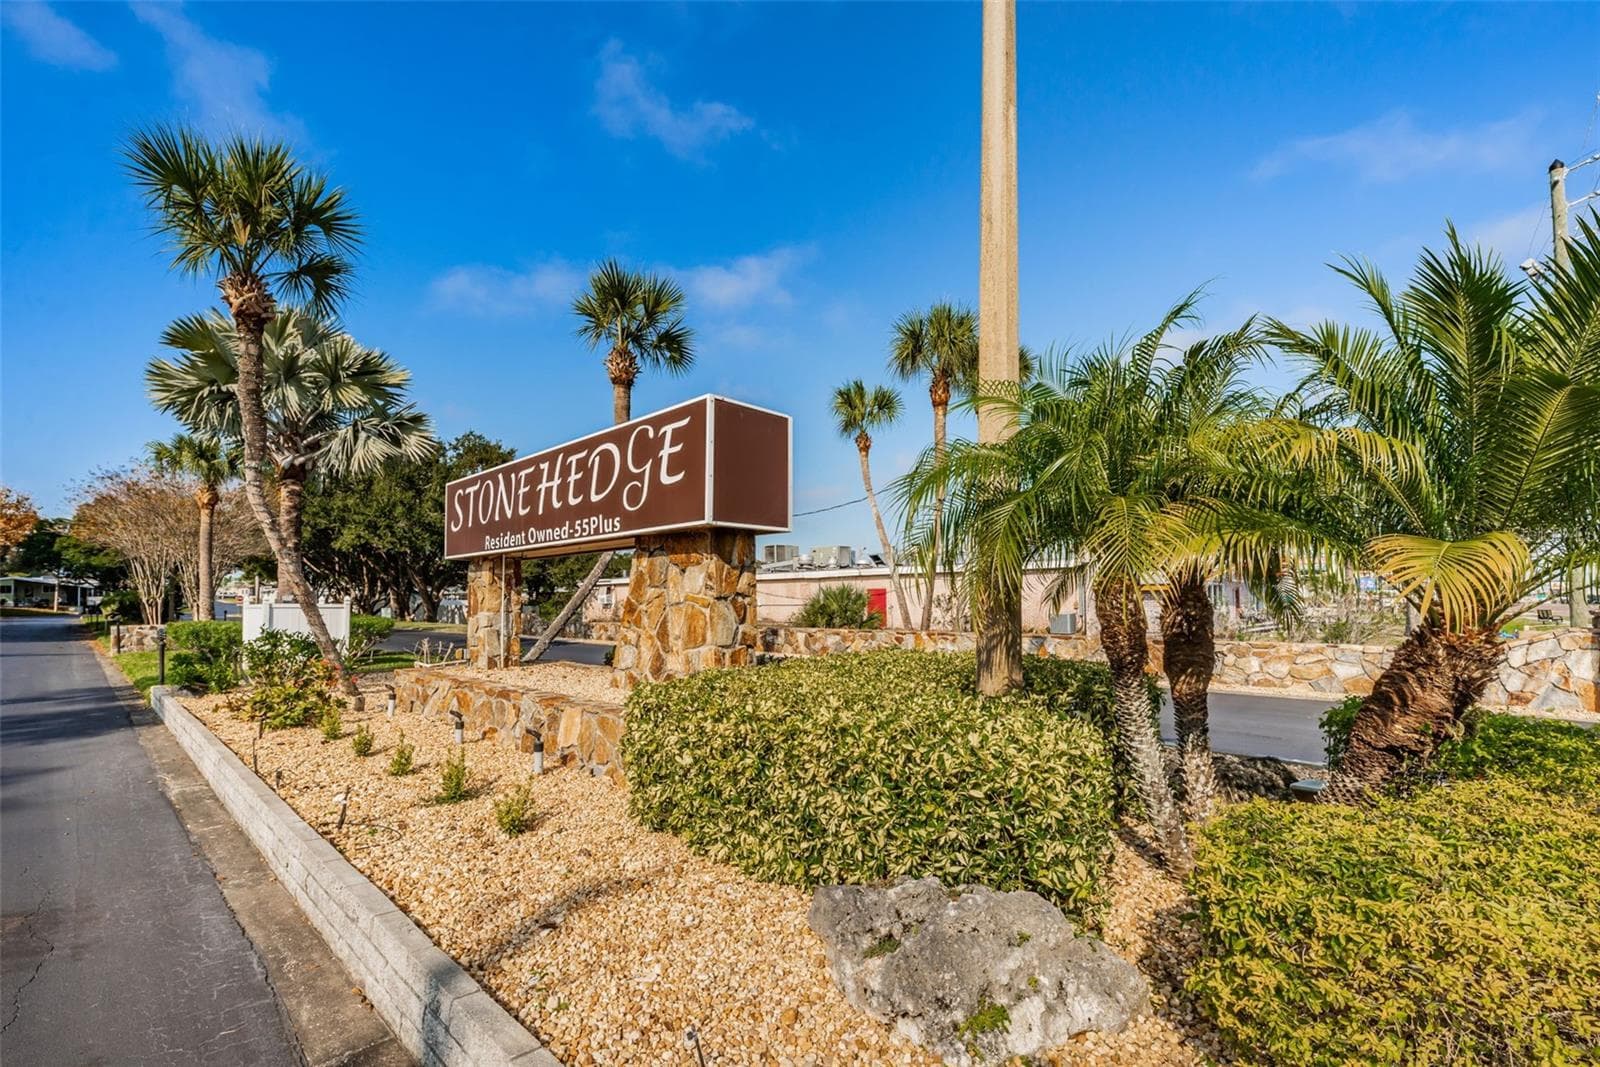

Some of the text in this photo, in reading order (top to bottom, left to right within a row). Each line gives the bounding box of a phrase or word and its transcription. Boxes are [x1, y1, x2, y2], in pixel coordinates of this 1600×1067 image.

[451, 416, 692, 532] STONEHEDGE
[485, 515, 621, 550] Resident Owned-55Plus
